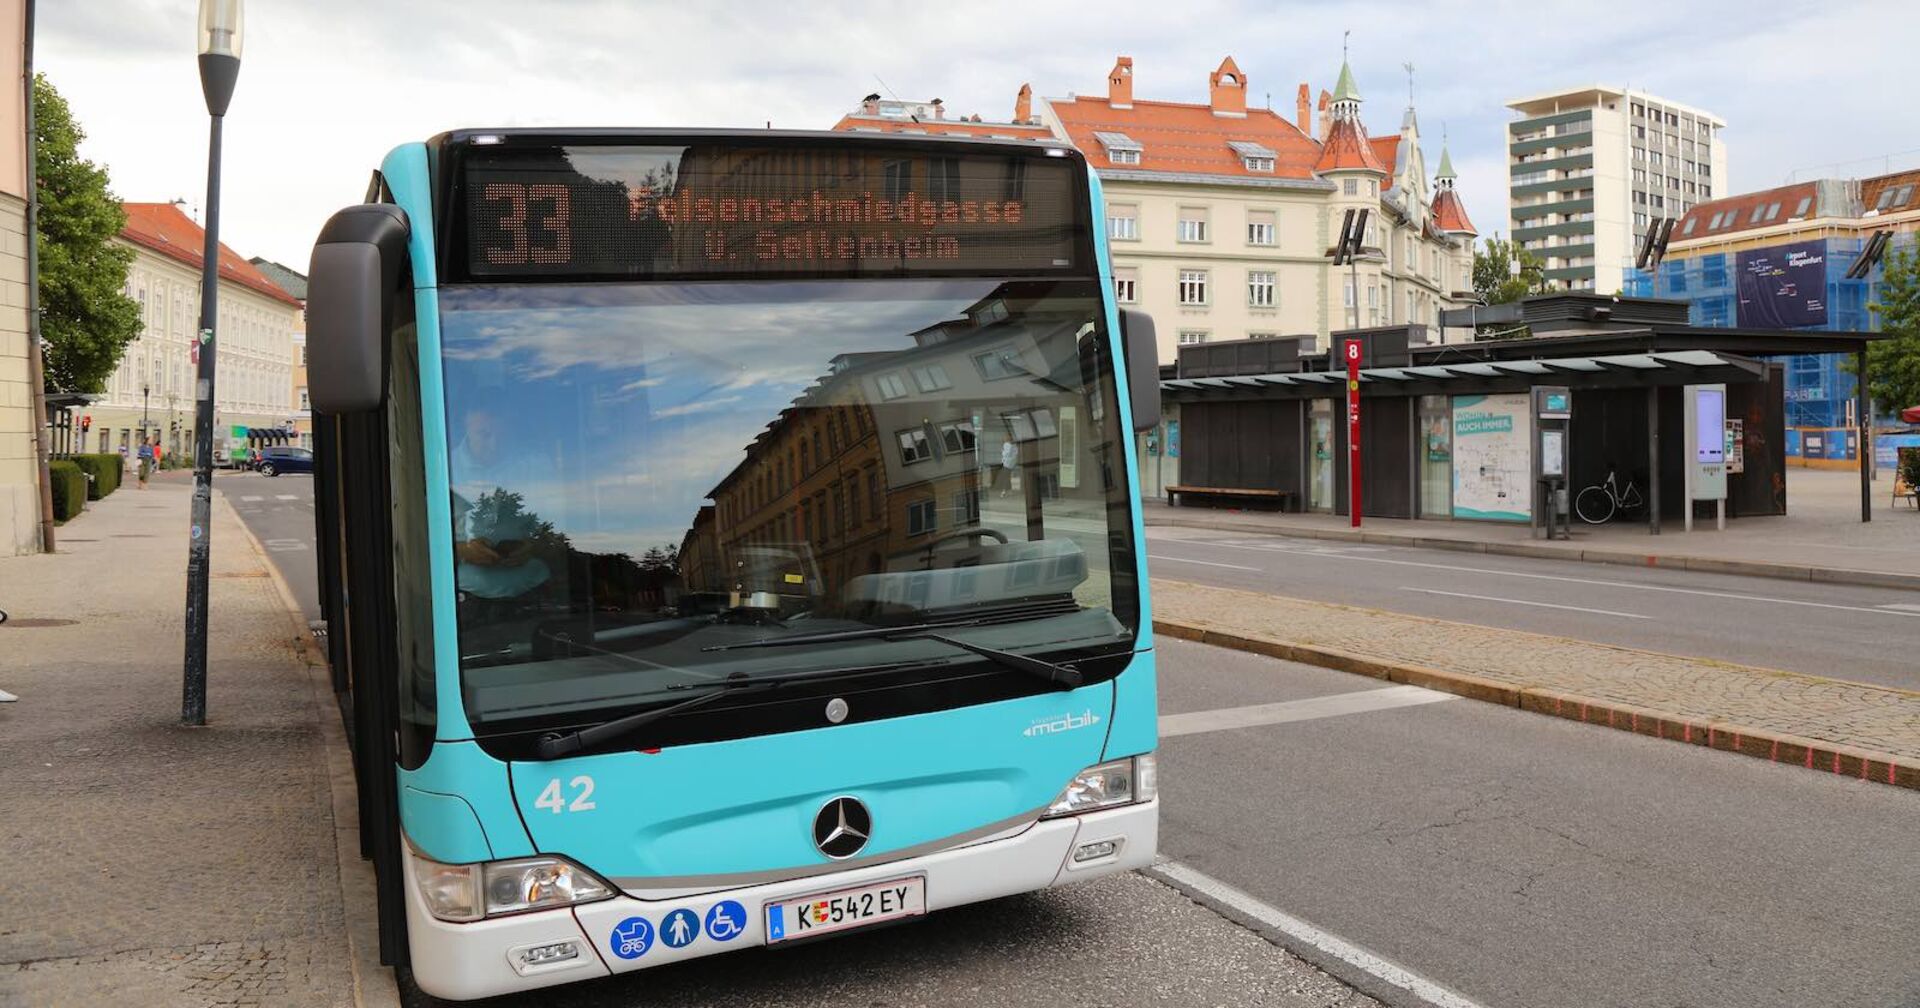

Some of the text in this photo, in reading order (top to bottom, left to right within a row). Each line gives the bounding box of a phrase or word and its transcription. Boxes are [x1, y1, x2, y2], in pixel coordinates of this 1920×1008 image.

[485, 183, 1024, 264] 33 Felsenschmiedgasse
[755, 230, 960, 260] Seltenheim
[1349, 344, 1358, 359] 8
[1457, 421, 1482, 433] AUCH
[1031, 709, 1090, 736] mobil
[534, 775, 596, 814] 42
